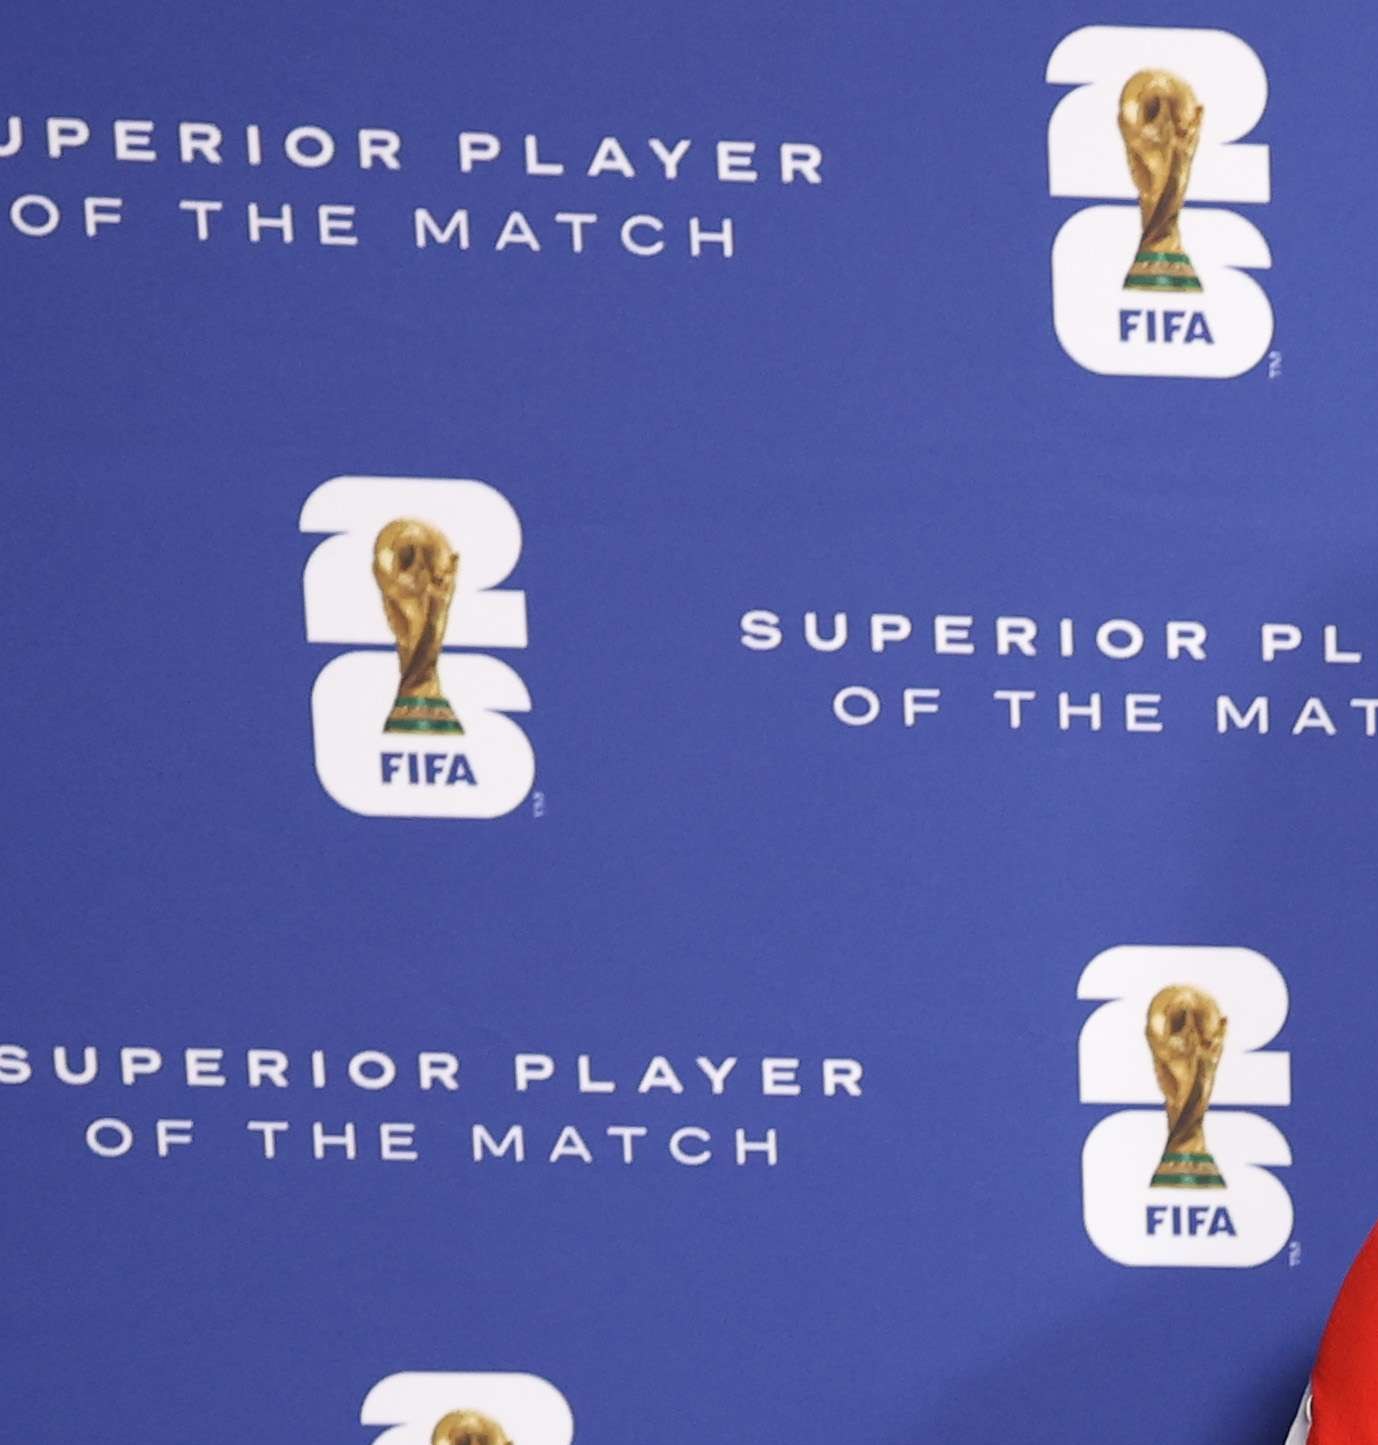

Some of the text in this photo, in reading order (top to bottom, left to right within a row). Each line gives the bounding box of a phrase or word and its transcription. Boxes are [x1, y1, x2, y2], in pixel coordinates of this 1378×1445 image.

[0, 116, 822, 184] PERIOR PLAYER
[10, 194, 733, 258] OF THE MATCH
[1120, 310, 1213, 343] FIFA
[741, 610, 1206, 660] SUPERIOR
[833, 686, 940, 726] OF
[994, 690, 1163, 732] THE
[381, 753, 476, 785] FIFA
[0, 1045, 862, 1096] SUPERIOR PLAYER
[86, 1118, 777, 1166] OF THE MATCH
[1147, 1206, 1236, 1236] FIFA
